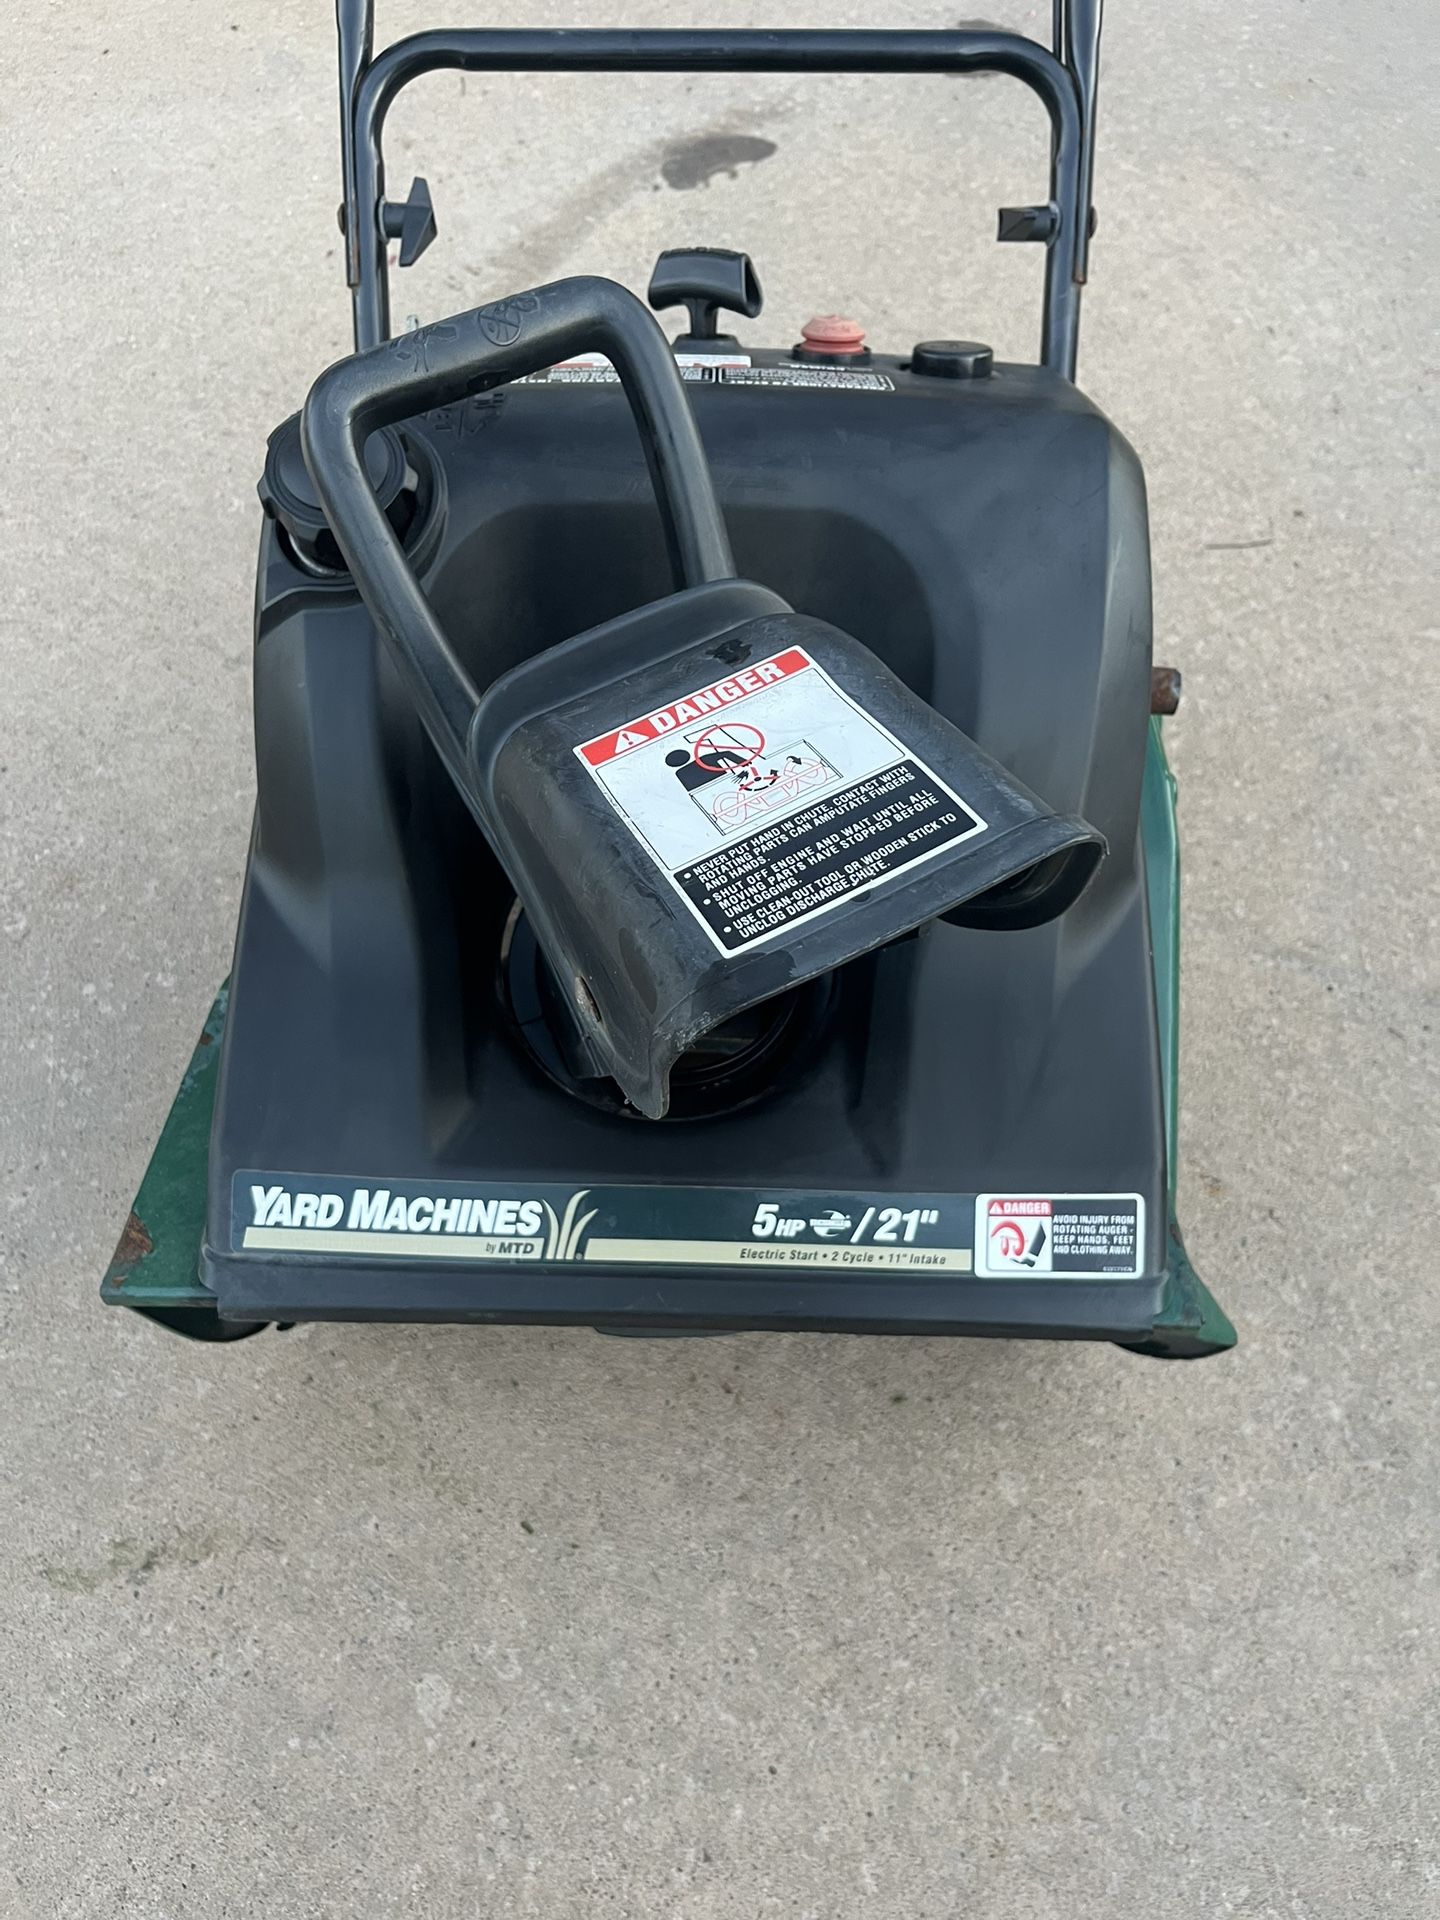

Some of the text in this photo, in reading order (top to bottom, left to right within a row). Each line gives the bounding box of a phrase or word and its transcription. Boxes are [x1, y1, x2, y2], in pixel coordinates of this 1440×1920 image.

[648, 662, 786, 733] DANGER
[692, 766, 908, 876] NEVER PUT HAND IN CHUTE. CONTACT WITH
[698, 772, 916, 883] ROTATING PARTS CAN AMPUTATE FINGERS
[712, 789, 932, 901] SHUT OFF ENGINE AND WAIT UNTIL ALL
[718, 795, 939, 910] MOVING PARTS HAVE STOPPED BEFORE
[705, 856, 770, 892] AND HANDS.
[732, 813, 957, 930] USE CLEAN-OUT TOOL OR WOODEN STICK TO
[724, 877, 803, 918] UNCLOGGING.
[739, 860, 891, 938] UNCLOG DISCHARGE CHUTE.
[1003, 1201, 1051, 1214] DANGER
[1053, 1214, 1135, 1225] AVOID INJURY FROM
[485, 1242, 535, 1255] by MTD
[1053, 1225, 1096, 1234] ROTATING
[1098, 1225, 1128, 1234] AUGER
[1053, 1235, 1077, 1244] KEEP
[1113, 1235, 1134, 1244] FEET
[739, 1248, 785, 1260] Electric
[789, 1250, 818, 1261] Start
[831, 1253, 839, 1262] 2
[842, 1253, 874, 1264] Cycle
[909, 1253, 946, 1265] Intake
[1053, 1245, 1070, 1254] AND
[1070, 1245, 1108, 1254] CLOTHING
